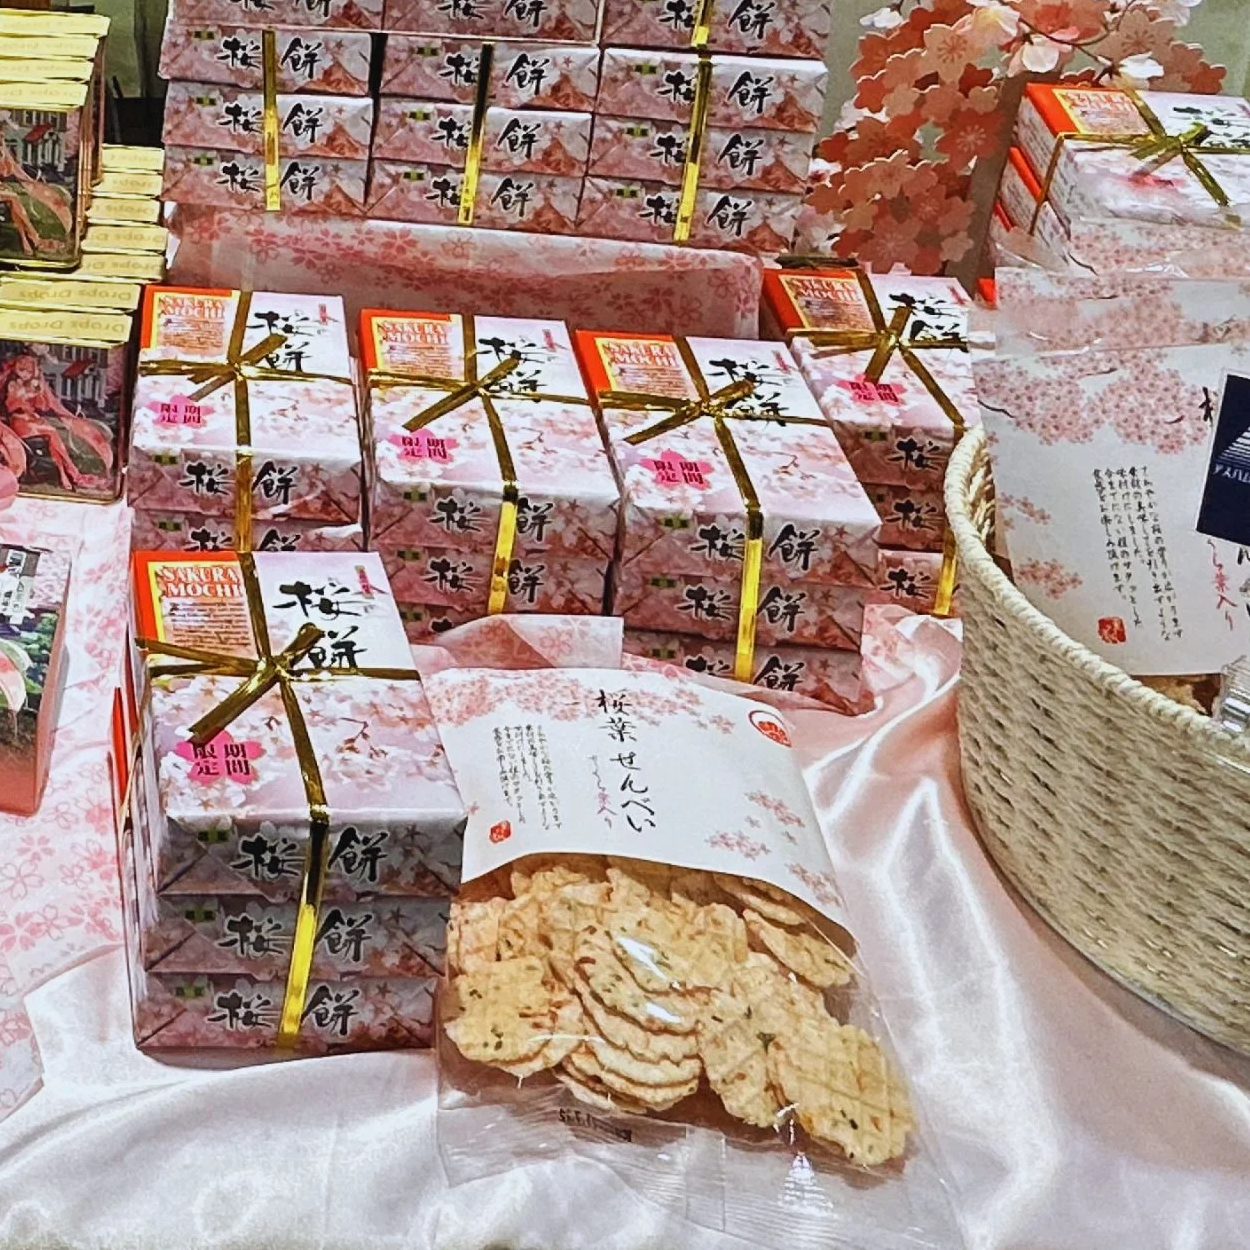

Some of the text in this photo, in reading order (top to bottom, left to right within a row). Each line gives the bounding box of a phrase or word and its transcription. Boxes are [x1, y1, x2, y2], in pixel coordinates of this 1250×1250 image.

[217, 37, 323, 80] 桜餅
[439, 52, 550, 96] 桜餅
[657, 71, 775, 114] 桜餅
[219, 102, 324, 143] 桜餅
[430, 117, 542, 159] 桜餅
[216, 161, 322, 201] 桜餅
[426, 177, 535, 218] 桜餅
[639, 195, 753, 237] 桜餅
[165, 297, 223, 308] SAKURA
[166, 307, 225, 318] MOCHI
[384, 322, 447, 333] SAKURA
[386, 333, 448, 344] MOCHI
[609, 342, 675, 356] SAKURA
[613, 354, 680, 367] MOCHI
[180, 460, 300, 505] 桜餅
[430, 497, 554, 542] 桜餅
[695, 523, 823, 573] 桜餅
[161, 566, 240, 583] SAKURA
[167, 583, 244, 598] MOCHI
[423, 558, 546, 603] 桜餅
[676, 584, 808, 634] 桜餅
[230, 827, 390, 882] 桜餅
[217, 909, 376, 963] 桜餅
[207, 985, 363, 1036] 桜餅
